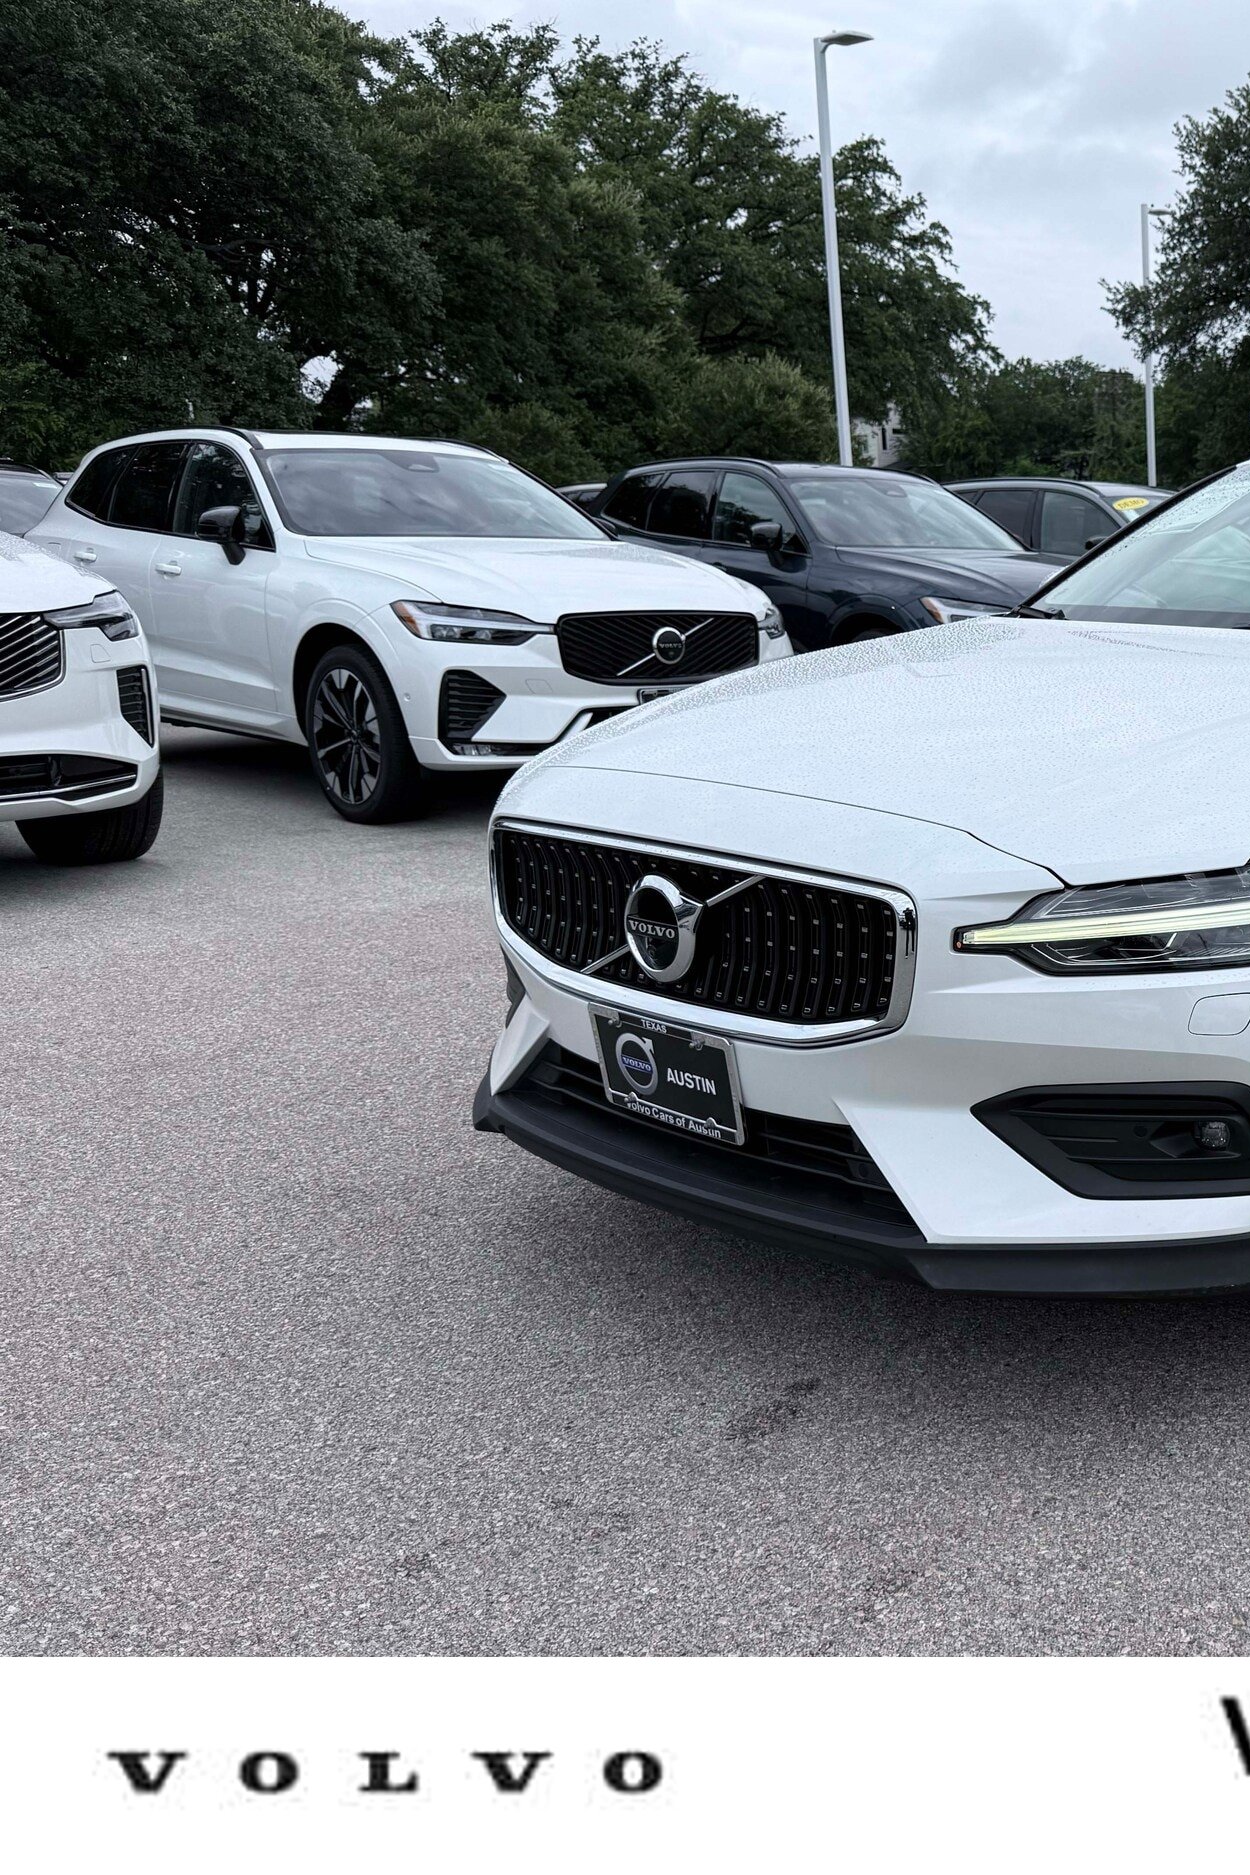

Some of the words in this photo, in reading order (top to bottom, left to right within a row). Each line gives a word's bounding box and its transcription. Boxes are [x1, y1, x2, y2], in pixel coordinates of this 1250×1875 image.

[628, 920, 676, 939] VOLVO
[640, 1018, 668, 1034] TEXAS
[622, 1056, 652, 1072] VOLVO
[666, 1067, 717, 1096] AUSTIN
[651, 1107, 674, 1124] Cars
[675, 1117, 686, 1127] of
